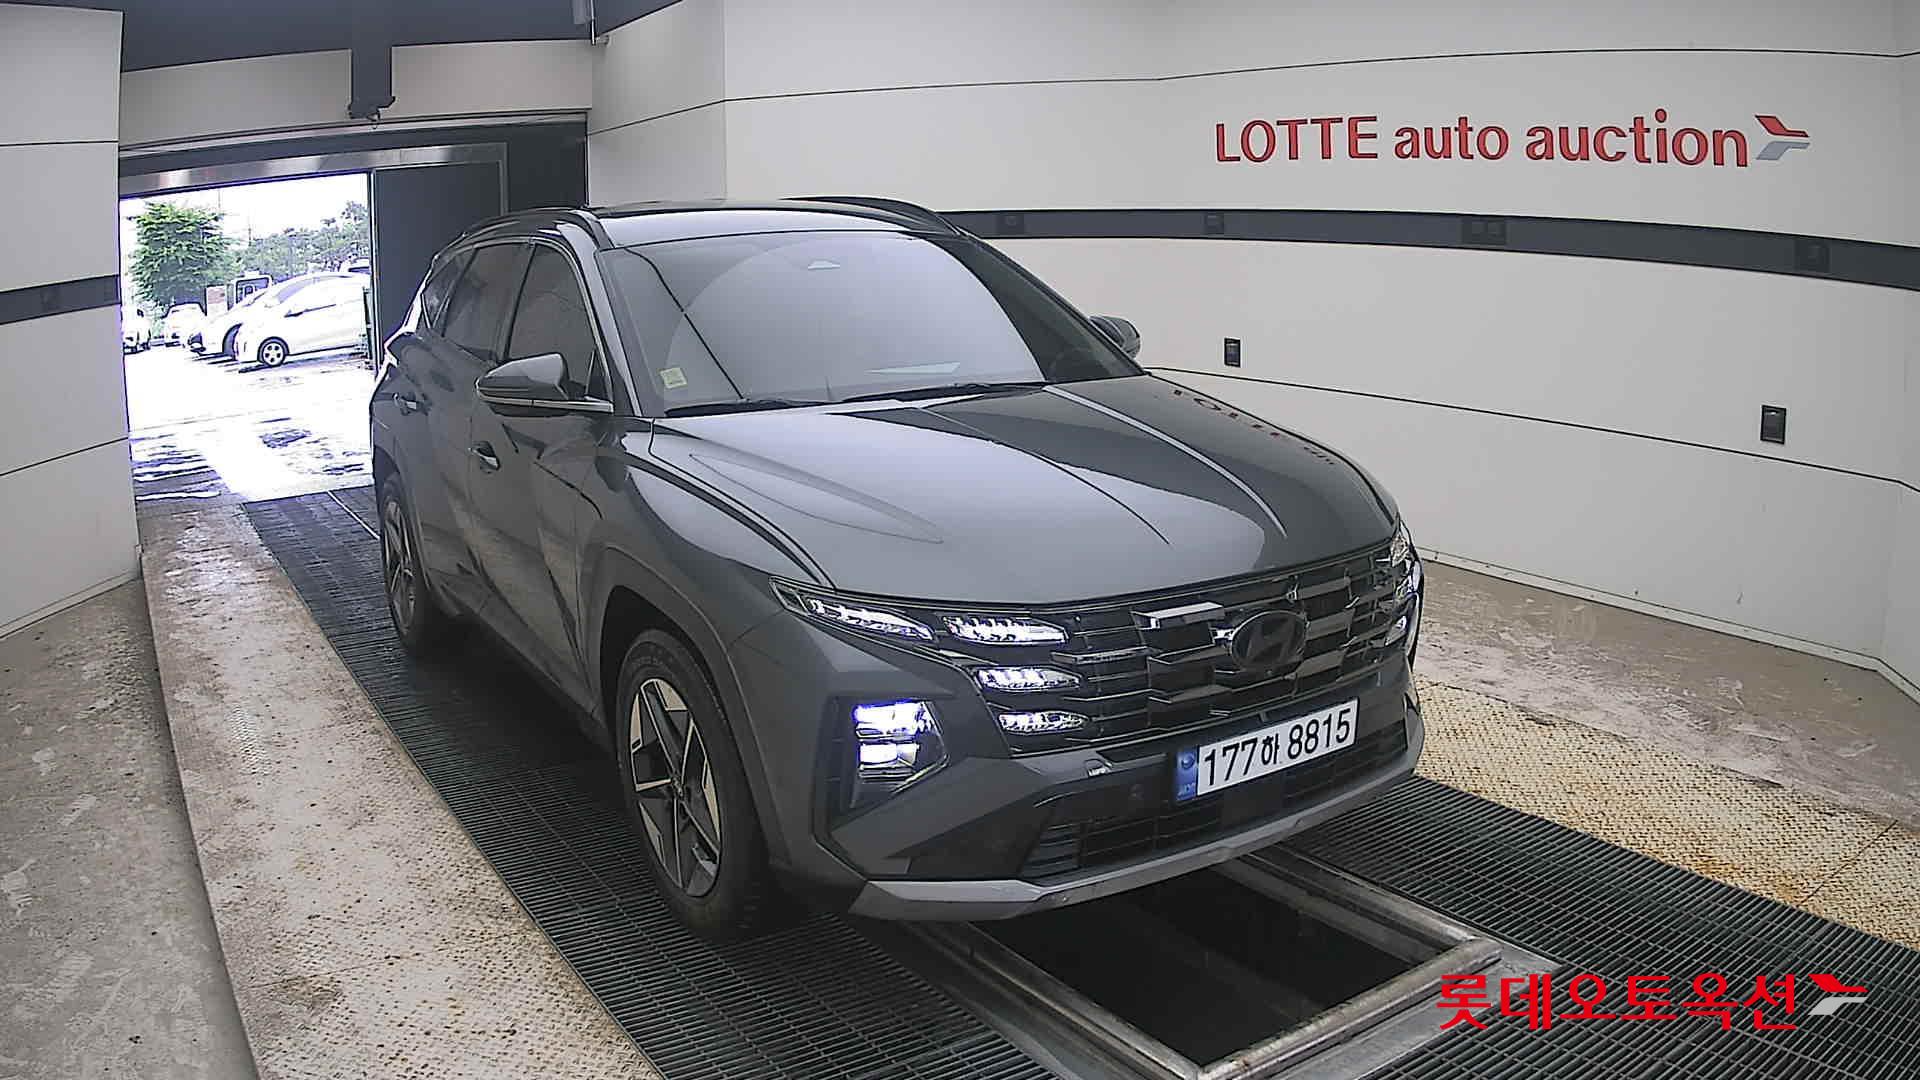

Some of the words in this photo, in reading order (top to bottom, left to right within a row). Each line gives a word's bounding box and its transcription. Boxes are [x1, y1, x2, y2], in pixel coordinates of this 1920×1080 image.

[1216, 115, 1378, 162] LOTTE
[1394, 116, 1510, 160] auto
[1525, 108, 1749, 167] auction
[1204, 733, 1280, 786] 177하
[1287, 709, 1351, 760] 8815
